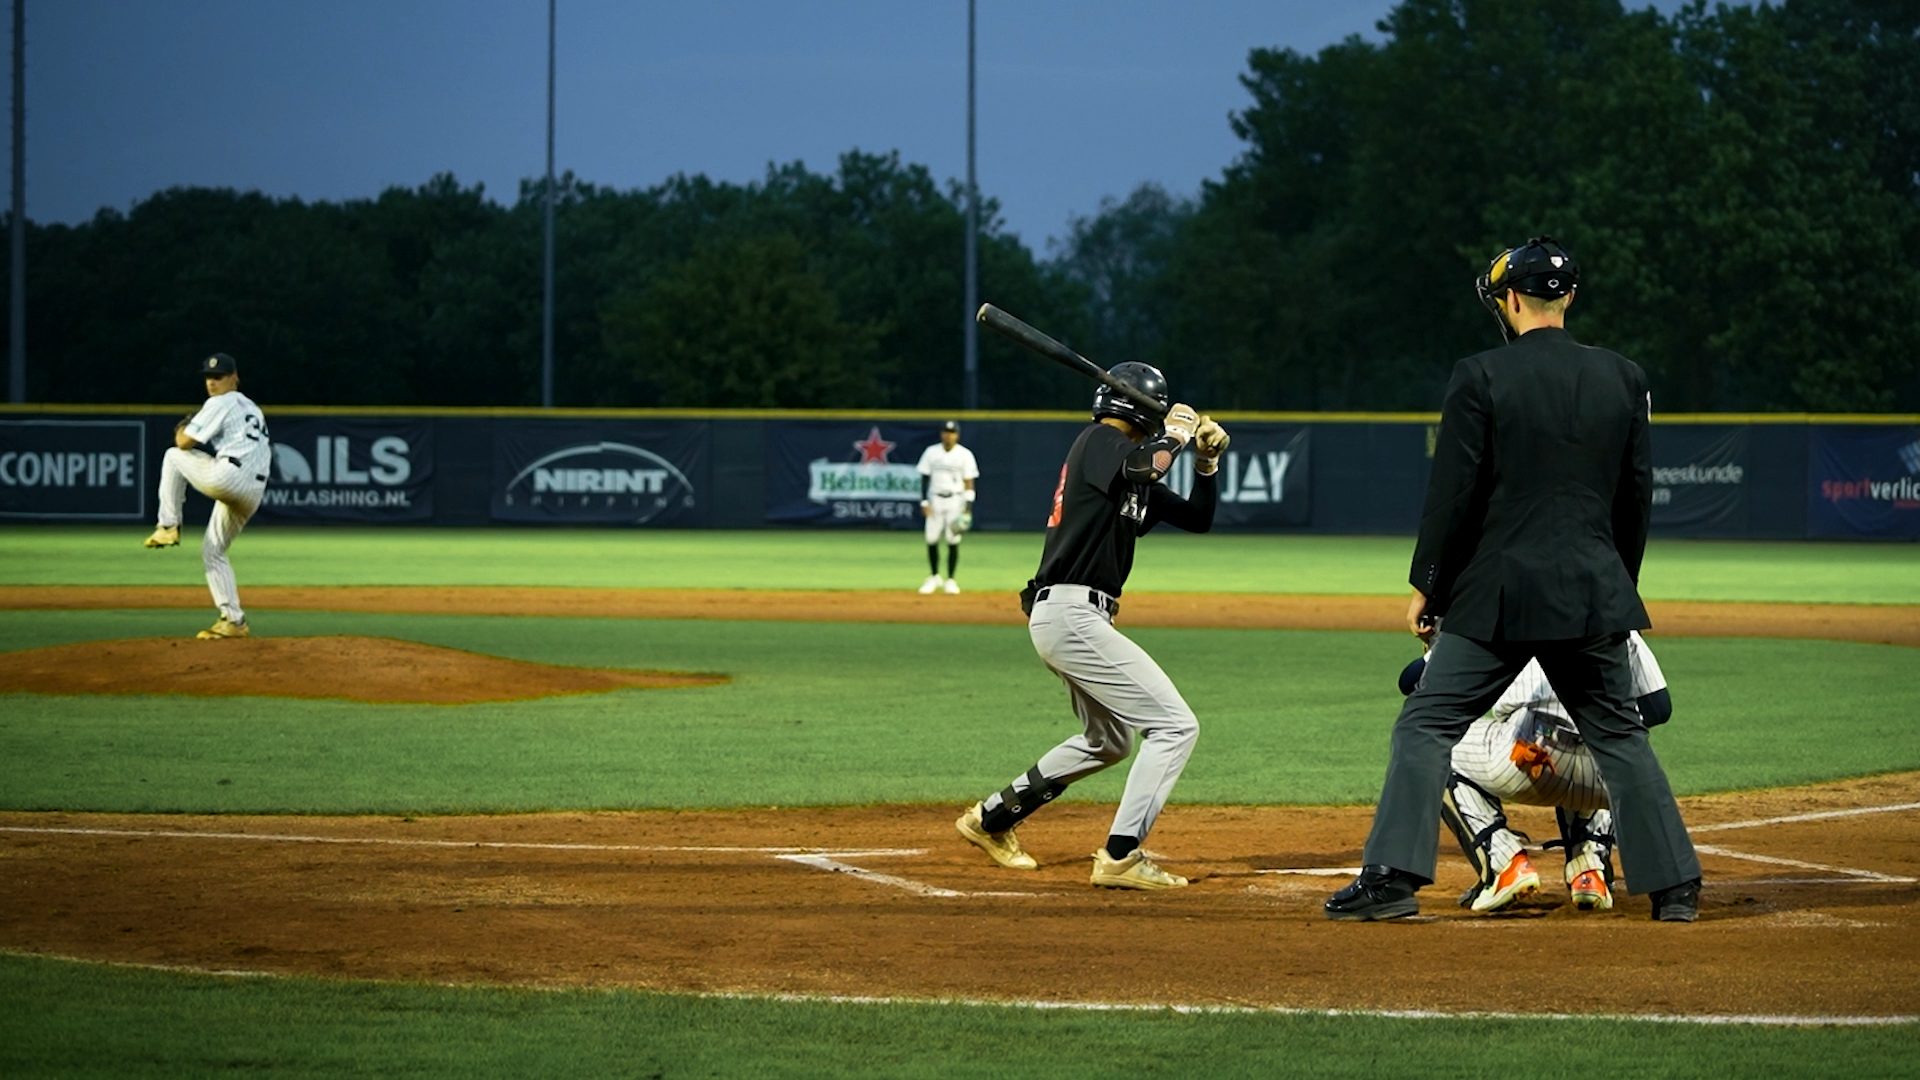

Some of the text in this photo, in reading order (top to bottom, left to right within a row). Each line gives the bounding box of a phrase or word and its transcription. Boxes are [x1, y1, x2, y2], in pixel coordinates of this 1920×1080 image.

[0, 452, 134, 486] CONPIPE
[534, 468, 668, 493] NIRINT
[833, 502, 913, 518] SILVER
